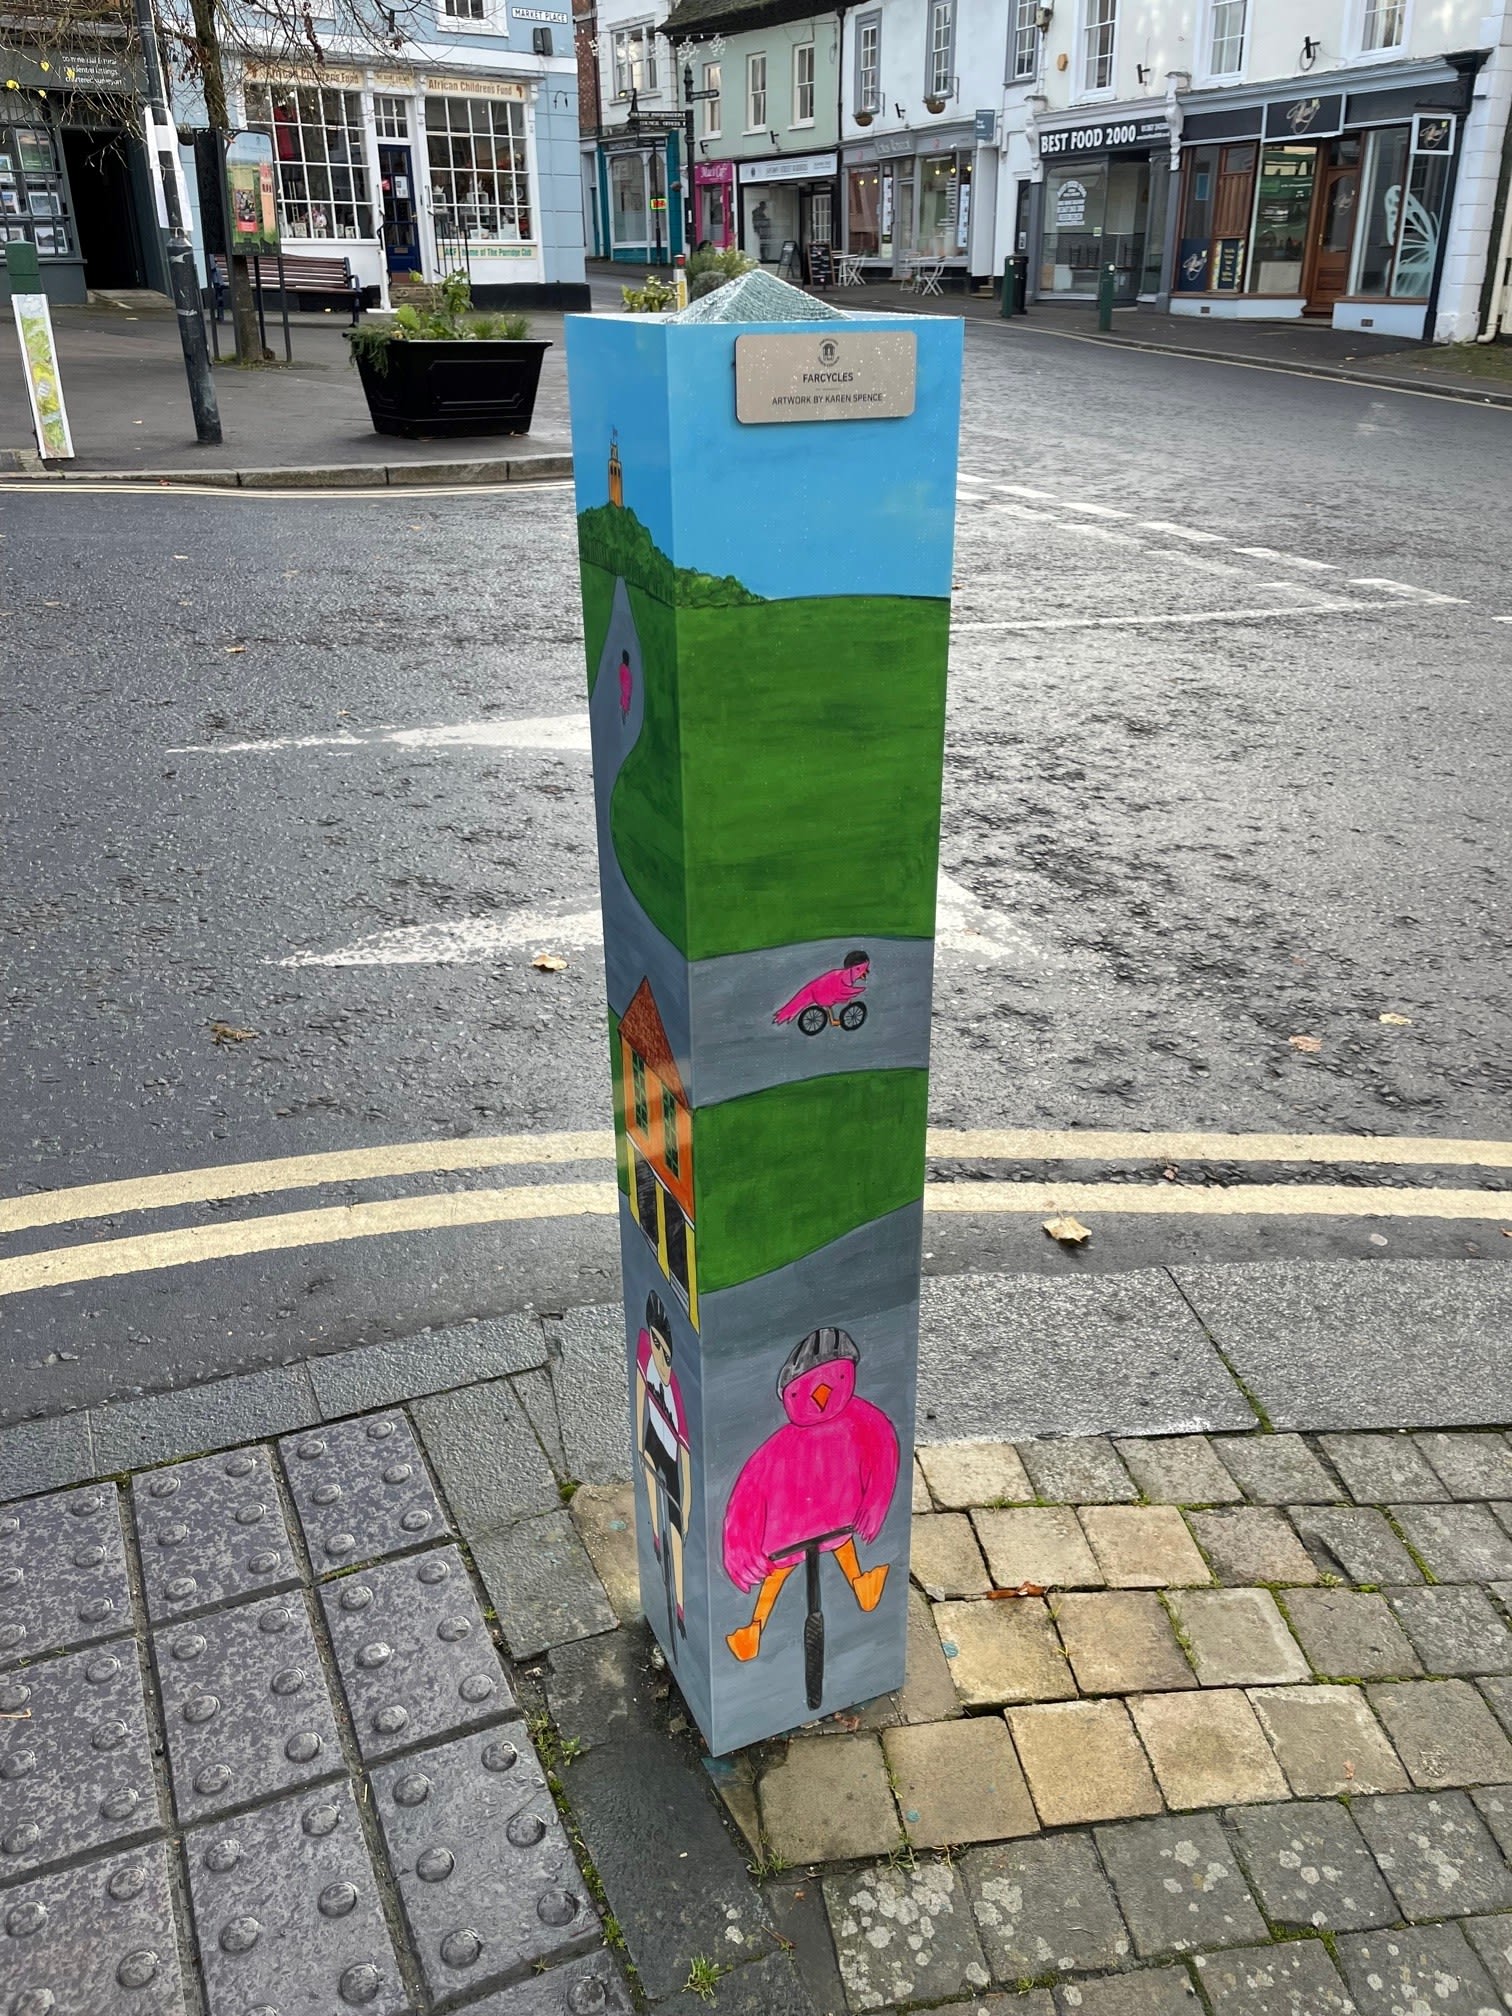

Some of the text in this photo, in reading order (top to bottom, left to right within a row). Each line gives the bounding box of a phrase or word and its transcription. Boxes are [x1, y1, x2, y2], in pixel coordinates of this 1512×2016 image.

[515, 9, 566, 23] MARKET PLACE
[341, 72, 359, 84] Fund
[428, 80, 459, 91] African
[496, 84, 512, 96] Fund
[1040, 133, 1069, 154] BEST
[1070, 128, 1103, 150] FOOD
[1106, 124, 1137, 146] 2000
[487, 247, 497, 256] The
[521, 247, 532, 257] Club
[802, 371, 854, 383] FARCYCLES
[771, 392, 882, 406] ARTWORK BY KAREN SPENCE
